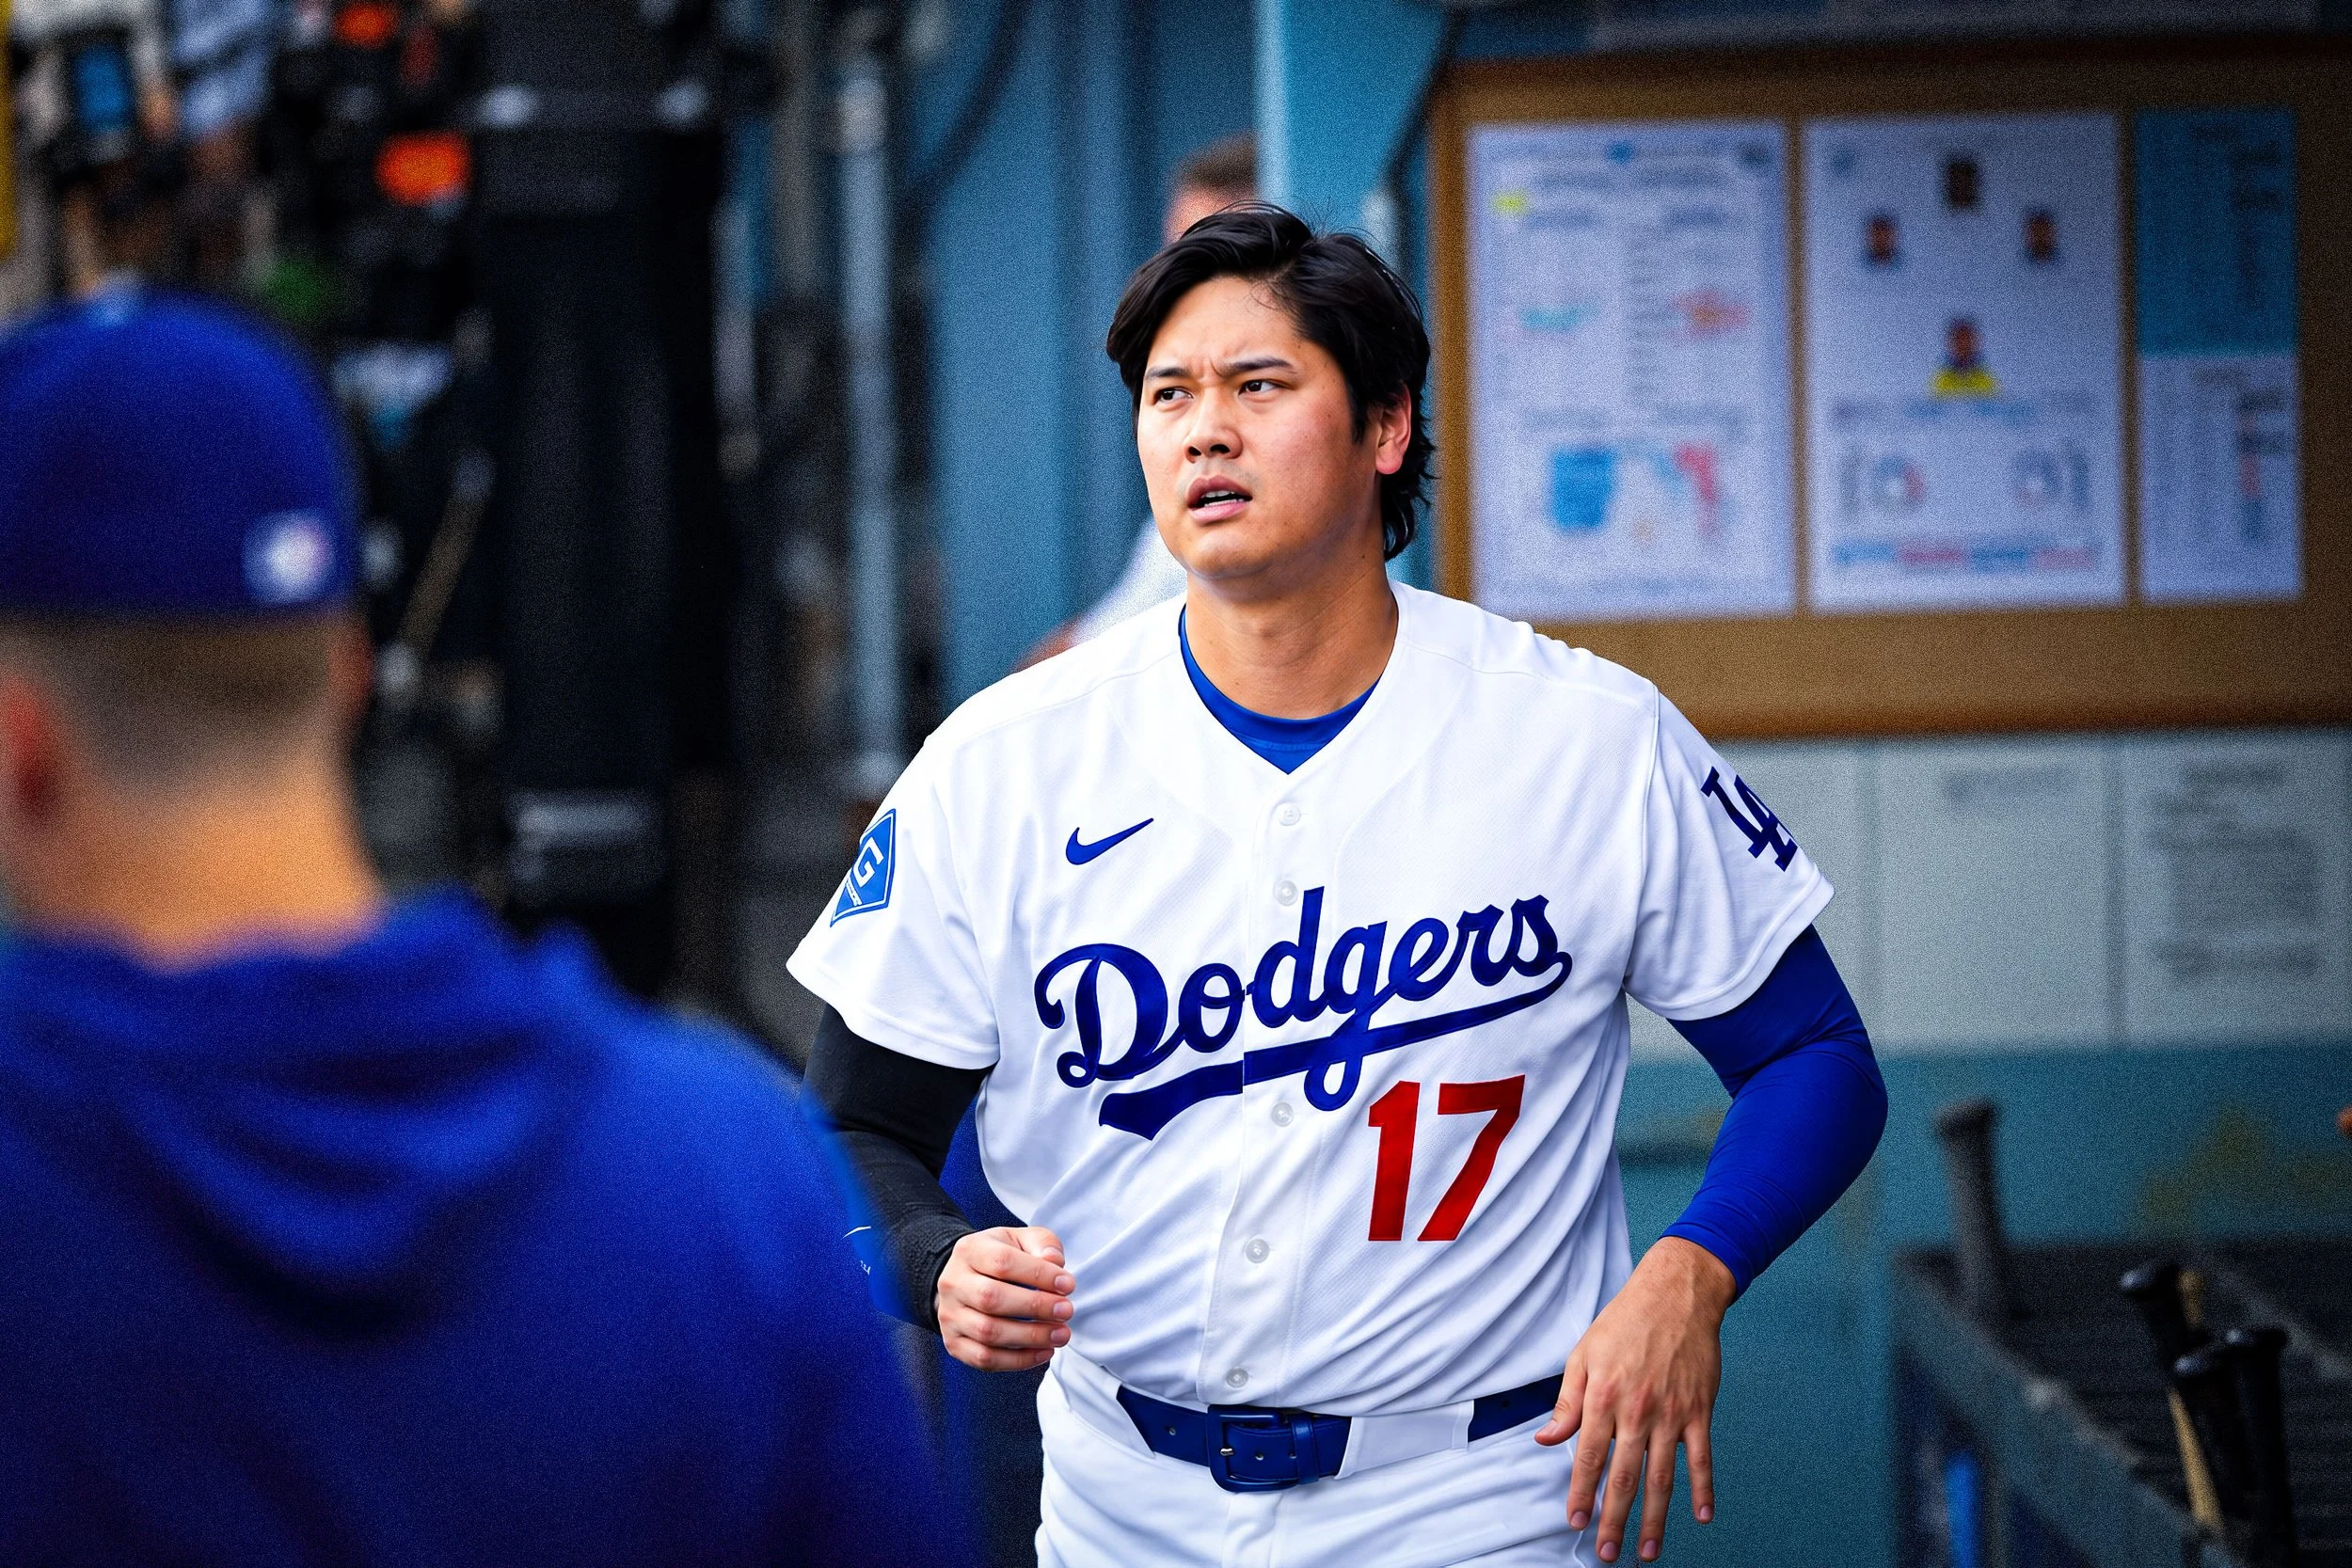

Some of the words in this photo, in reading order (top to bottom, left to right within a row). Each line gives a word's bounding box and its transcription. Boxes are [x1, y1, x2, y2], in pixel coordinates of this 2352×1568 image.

[852, 836, 884, 888] G
[1700, 766, 1798, 872] LA
[1034, 886, 1573, 1111] Dodgers
[1368, 1074, 1525, 1241] 17
